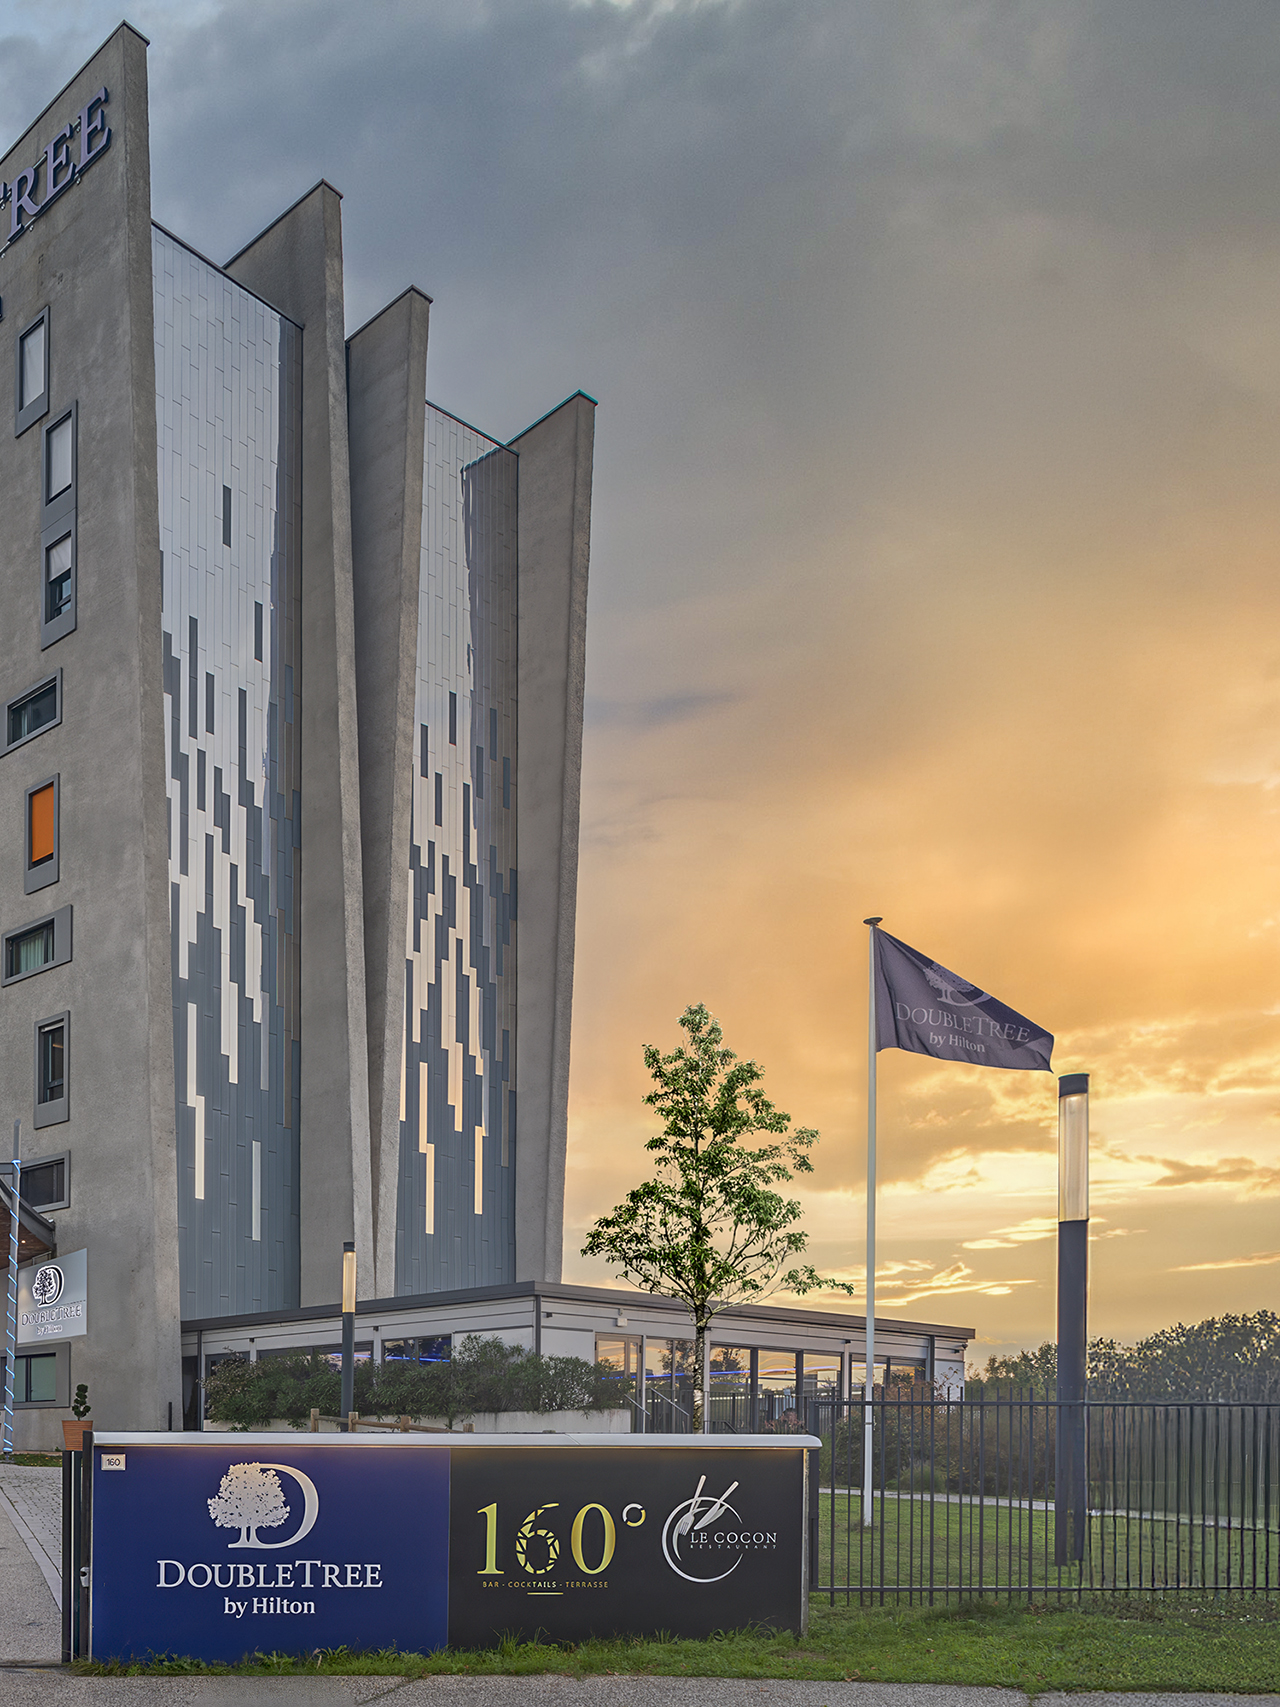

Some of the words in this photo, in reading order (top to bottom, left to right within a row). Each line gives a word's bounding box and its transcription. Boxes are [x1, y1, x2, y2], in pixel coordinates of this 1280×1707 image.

[896, 1003, 1030, 1042] DOUBLETREE
[929, 1032, 946, 1048] by
[948, 1034, 986, 1053] Hilton
[106, 1457, 121, 1467] 160
[690, 1532, 708, 1544] LE
[714, 1532, 777, 1544] COCON
[156, 1560, 383, 1588] DOUBLETREE
[224, 1597, 248, 1619] by
[252, 1597, 316, 1615] Hilton
